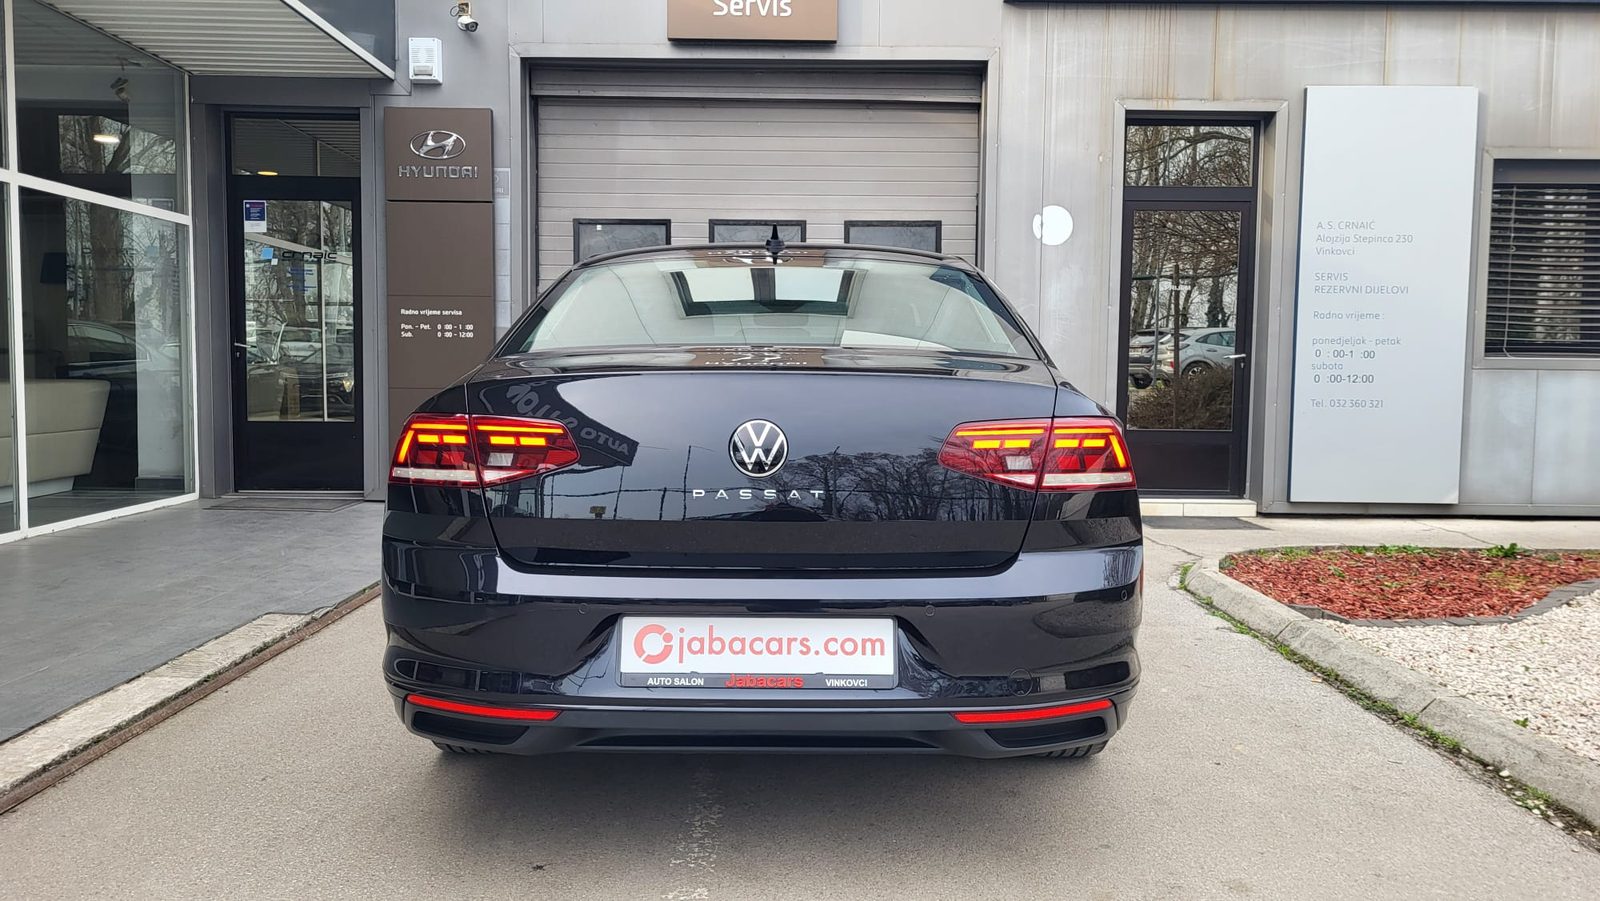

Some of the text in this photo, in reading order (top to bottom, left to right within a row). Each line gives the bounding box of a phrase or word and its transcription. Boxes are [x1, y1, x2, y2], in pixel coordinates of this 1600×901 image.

[712, 0, 793, 17] Servis
[398, 165, 479, 178] HYUNDAI
[1315, 234, 1414, 245] Alojzija Stepinca 230
[1315, 247, 1355, 256] Vinkovci
[1314, 272, 1349, 281] SERVIS
[1314, 285, 1409, 294] REZERVNI DIJELOVI
[420, 308, 441, 316] vrijeme
[1313, 311, 1343, 320] Radno
[1345, 311, 1380, 321] vrijeme
[1312, 336, 1367, 347] ponedjeljak
[1375, 336, 1402, 346] petak
[1311, 362, 1344, 370] subota
[1311, 399, 1384, 408] Tel. 032 360 321
[692, 488, 825, 500] PASSAT
[678, 624, 886, 664] jabacars.com
[647, 677, 704, 687] AUTO SALON
[724, 673, 804, 689] Jabacars
[825, 678, 868, 688] VINKOVCI
